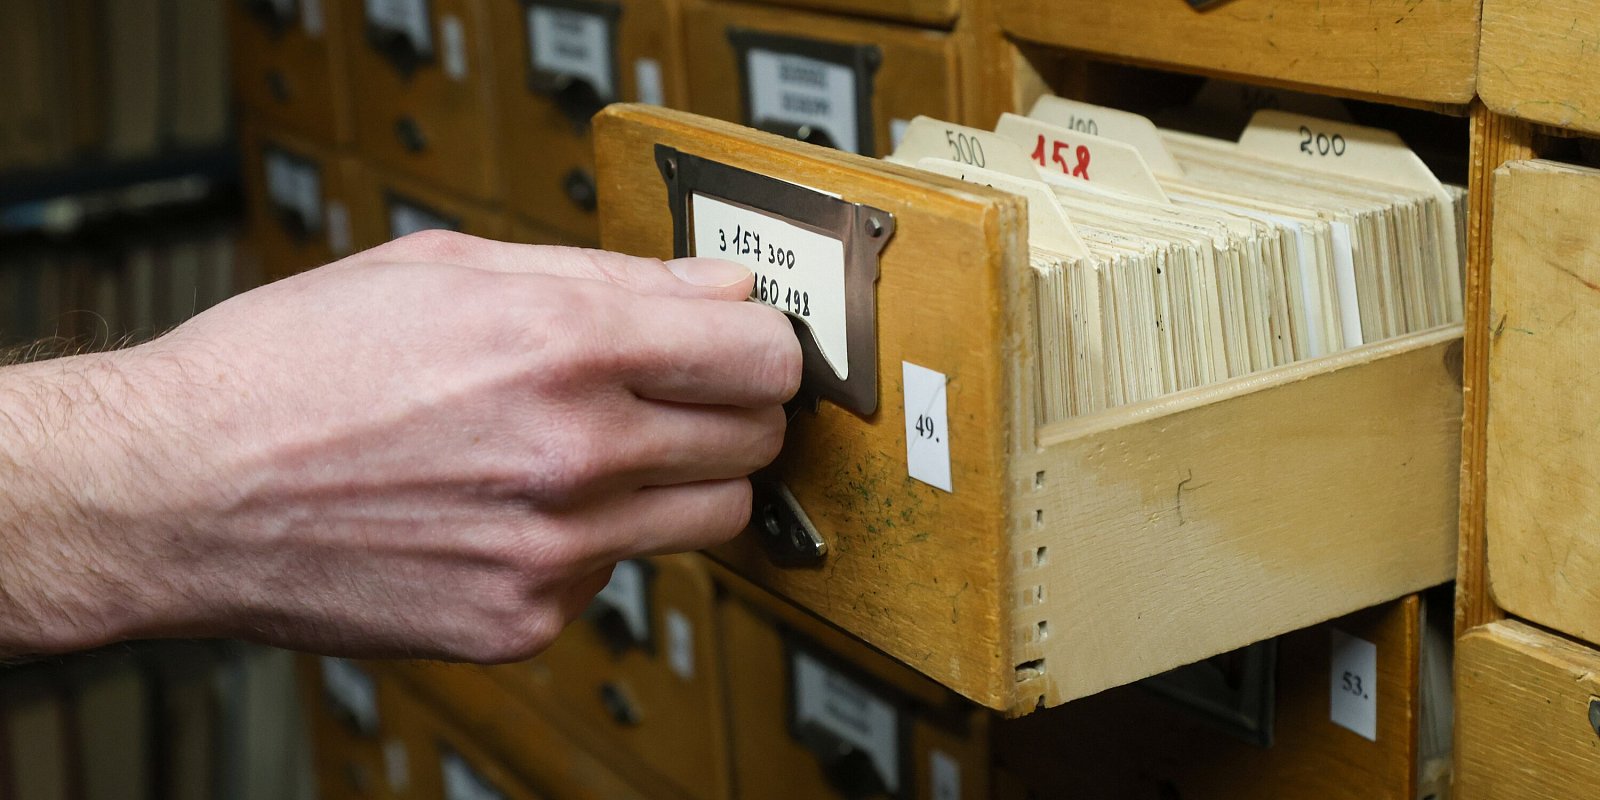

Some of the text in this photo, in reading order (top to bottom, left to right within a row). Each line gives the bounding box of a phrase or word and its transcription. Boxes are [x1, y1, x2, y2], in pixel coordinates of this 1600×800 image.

[945, 129, 986, 168] 500
[1031, 134, 1091, 181] 158
[1299, 125, 1346, 157] 200
[718, 224, 795, 269] 3 157 300
[753, 272, 811, 316] 160 198
[915, 413, 940, 444] 49.
[1341, 670, 1369, 700] 53.
